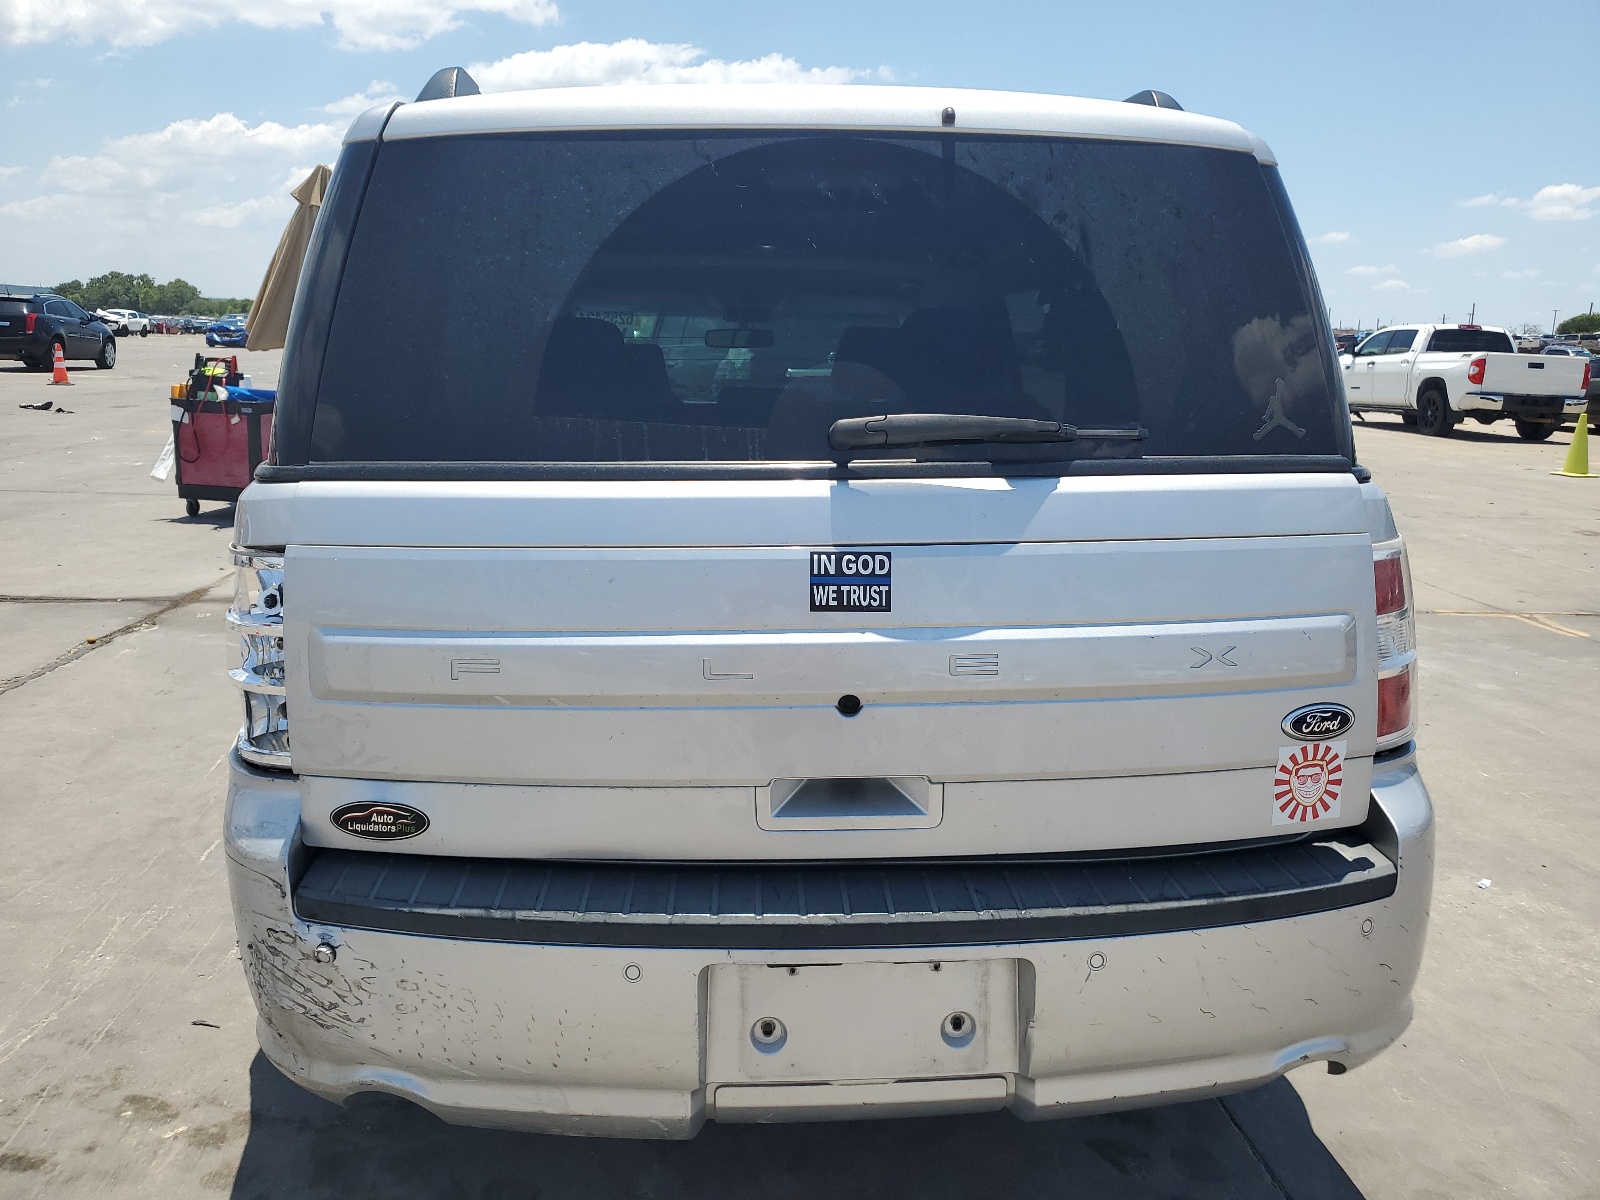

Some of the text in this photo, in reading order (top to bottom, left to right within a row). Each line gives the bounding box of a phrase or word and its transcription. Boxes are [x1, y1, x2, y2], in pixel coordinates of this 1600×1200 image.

[813, 554, 890, 575] IN GOD
[813, 585, 889, 607] WE TRUST
[1302, 711, 1342, 733] Ford
[370, 812, 394, 823] Auto
